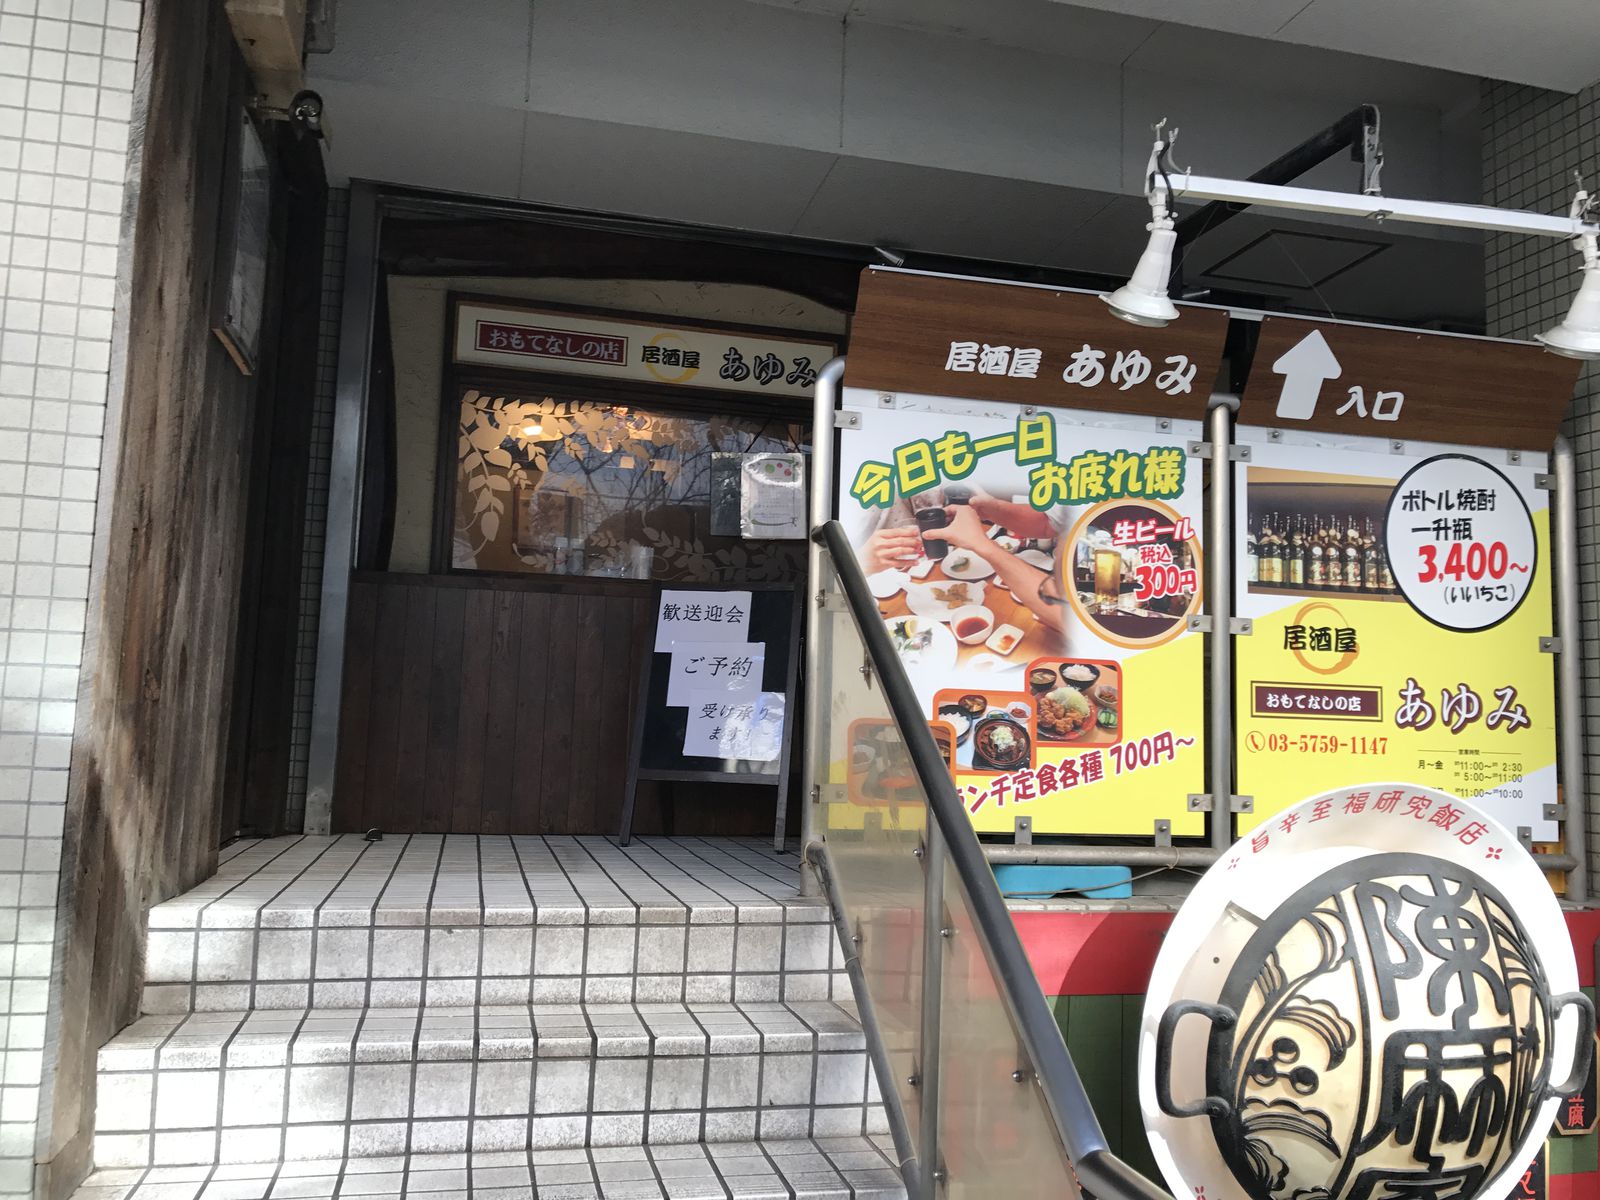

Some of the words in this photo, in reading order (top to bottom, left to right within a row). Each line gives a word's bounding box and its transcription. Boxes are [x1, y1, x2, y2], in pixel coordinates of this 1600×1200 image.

[489, 328, 620, 361] おもてなしの店
[641, 344, 700, 370] 居酒屋
[719, 347, 818, 387] あゆみ
[945, 341, 1043, 379] 居酒屋
[1063, 344, 1198, 396] あゆみ
[1336, 385, 1405, 422] 入口
[851, 411, 1057, 509] 今日も一日
[1029, 446, 1187, 512] お疲れ様
[1401, 488, 1497, 512] ボトル焼酎
[1112, 516, 1195, 546] 生ビール
[1411, 517, 1473, 541] 一升瓶
[1138, 543, 1173, 564] 税込
[1134, 564, 1198, 602] 300円
[662, 603, 745, 624] 歓送迎会
[1283, 624, 1358, 654] 居酒屋
[684, 656, 753, 678] ご予約
[699, 703, 769, 721] 受け承り
[1266, 692, 1362, 712] おもてなしの店
[1394, 677, 1531, 735] あゆみ
[1268, 733, 1388, 756] 03-5759-1147
[1251, 789, 1491, 856] 旨辛至福研究飯店
